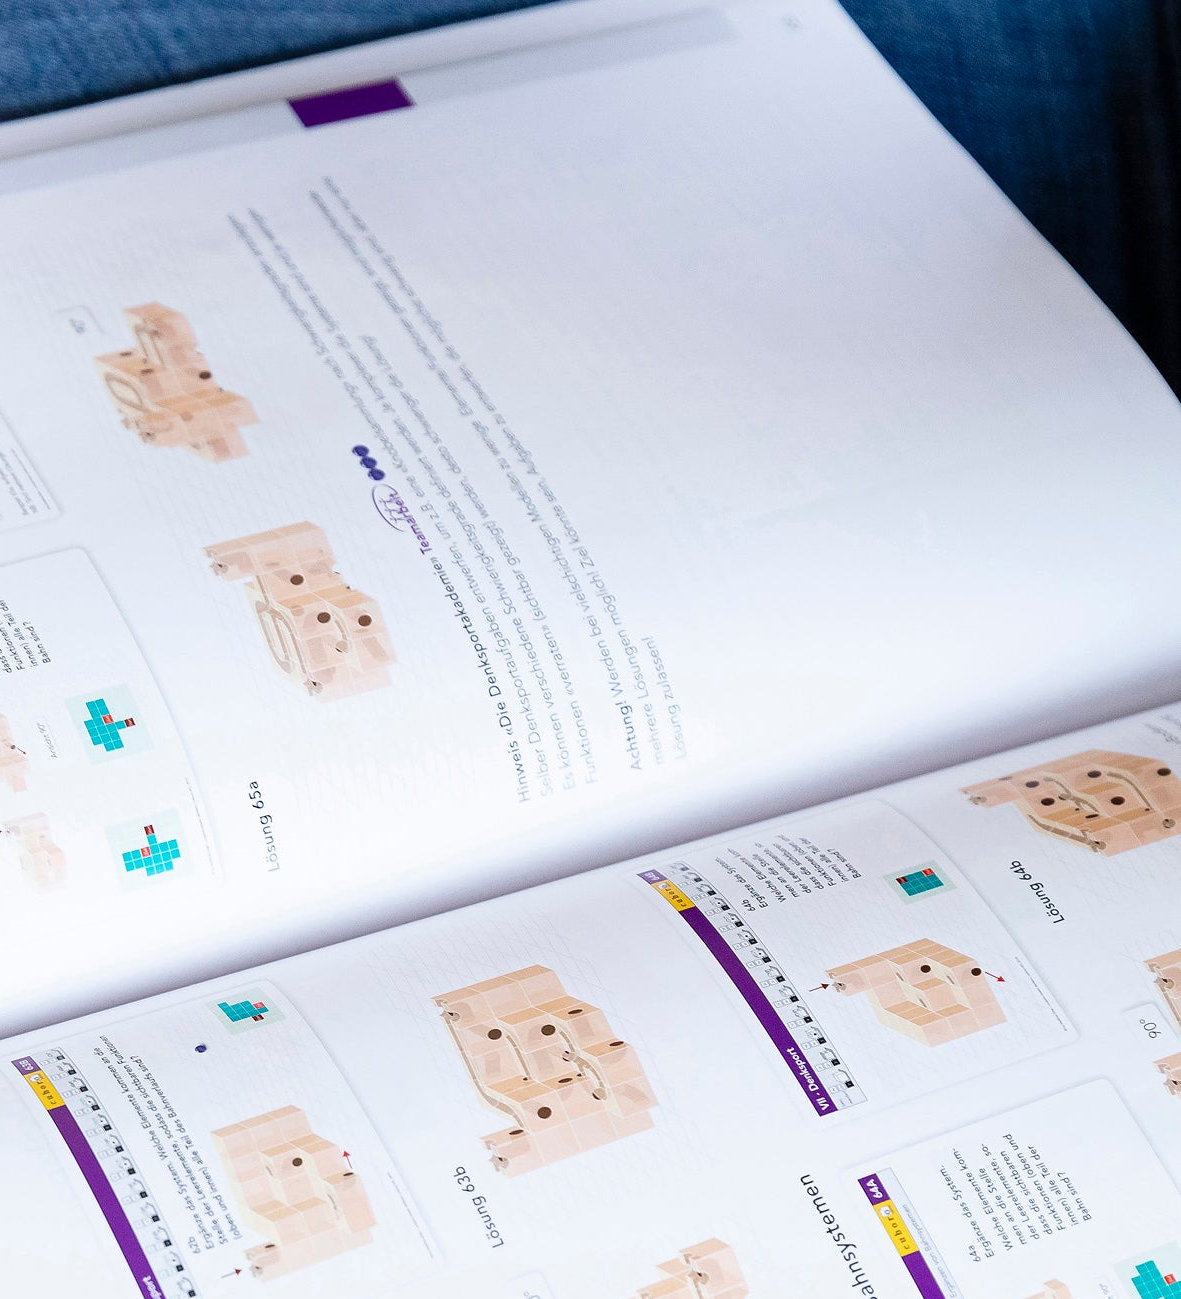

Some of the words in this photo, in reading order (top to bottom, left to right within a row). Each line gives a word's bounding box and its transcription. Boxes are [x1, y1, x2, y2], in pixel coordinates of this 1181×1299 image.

[389, 491, 433, 555] Teamarbeit
[434, 521, 452, 541] um
[446, 499, 517, 616] Schwierigkeitsgrade
[538, 523, 591, 613] vielschichtigen
[572, 545, 596, 569] Ziel
[448, 541, 487, 604] entwerfen,
[511, 569, 548, 622] (sichtbar
[586, 570, 623, 626] möglich!
[2, 612, 17, 628] Teil
[13, 627, 26, 641] alle
[429, 556, 502, 698] Denksportakademie»
[582, 614, 603, 638] bei
[0, 655, 13, 674] dass
[19, 642, 39, 668] innen)
[36, 643, 52, 664] Bahn
[512, 617, 555, 710] verschiedene
[541, 624, 574, 696] «verraten»
[617, 629, 650, 700] Lösungen
[481, 606, 542, 745] Denksportaufgaben
[596, 639, 624, 698] Werden
[640, 635, 675, 701] zulassen!
[496, 701, 514, 736] «Die
[549, 712, 572, 770] können
[570, 699, 599, 783] Funktionen
[614, 700, 643, 771] Achtung!
[507, 740, 531, 804] Hinweis
[534, 748, 555, 796] Selber
[248, 781, 265, 810] 65a
[259, 814, 281, 872] Lösung
[1009, 860, 1033, 881] 64b
[1029, 882, 1066, 924] Lösung
[1139, 1019, 1162, 1038] 90°
[93, 1047, 105, 1057] die
[99, 1035, 127, 1065] Funktionen
[100, 1056, 111, 1065] an
[107, 1064, 130, 1094] kommen
[123, 1064, 150, 1099] sichtbaren
[786, 1046, 820, 1092] Denksport
[143, 1072, 178, 1119] Bahnverlaufs
[146, 1099, 158, 1112] die
[815, 1096, 830, 1111] VII
[126, 1093, 152, 1130] Elemente
[154, 1112, 174, 1140] sodass
[173, 1118, 186, 1134] des
[148, 1129, 169, 1161] Welche
[179, 1134, 195, 1151] Teil
[981, 1143, 992, 1157] so-
[1002, 1133, 1020, 1151] und
[1027, 1145, 1041, 1161] der
[171, 1140, 206, 1201] Leerelemente,
[191, 1150, 204, 1165] alle
[952, 1148, 969, 1172] kom-
[1016, 1152, 1038, 1179] (oben
[1035, 1162, 1051, 1179] Teil
[166, 1160, 188, 1195] System.
[197, 1166, 219, 1194] innen)
[453, 1166, 476, 1193] 63b
[939, 1165, 963, 1201] System.
[978, 1167, 998, 1194] Stelle
[1000, 1150, 1031, 1197] sichtbaren
[1048, 1179, 1062, 1196] alle
[865, 1178, 884, 1199] 64A
[965, 1171, 995, 1215] Elemente
[990, 1157, 1031, 1223] Leerelemente,
[994, 1194, 1007, 1210] die
[183, 1195, 196, 1211] das
[202, 1201, 215, 1217] der
[212, 1194, 228, 1212] und
[959, 1201, 973, 1219] das
[1004, 1211, 1015, 1223] an
[1028, 1198, 1041, 1213] die
[1033, 1179, 1067, 1231] Funktionen
[1057, 1197, 1080, 1227] innen)
[1075, 1197, 1093, 1221] Bahn
[192, 1213, 216, 1250] Ergänze
[211, 1218, 229, 1245] Stelle
[224, 1213, 243, 1240] (oben
[471, 1195, 505, 1249] Lösung
[879, 1205, 912, 1253] cuboro
[991, 1216, 1014, 1252] Welche
[1012, 1224, 1028, 1245] men
[1026, 1224, 1041, 1240] der
[1037, 1214, 1054, 1235] dass
[187, 1236, 202, 1255] 62b
[968, 1244, 982, 1263] 64a
[970, 1220, 995, 1259] Ergänze
